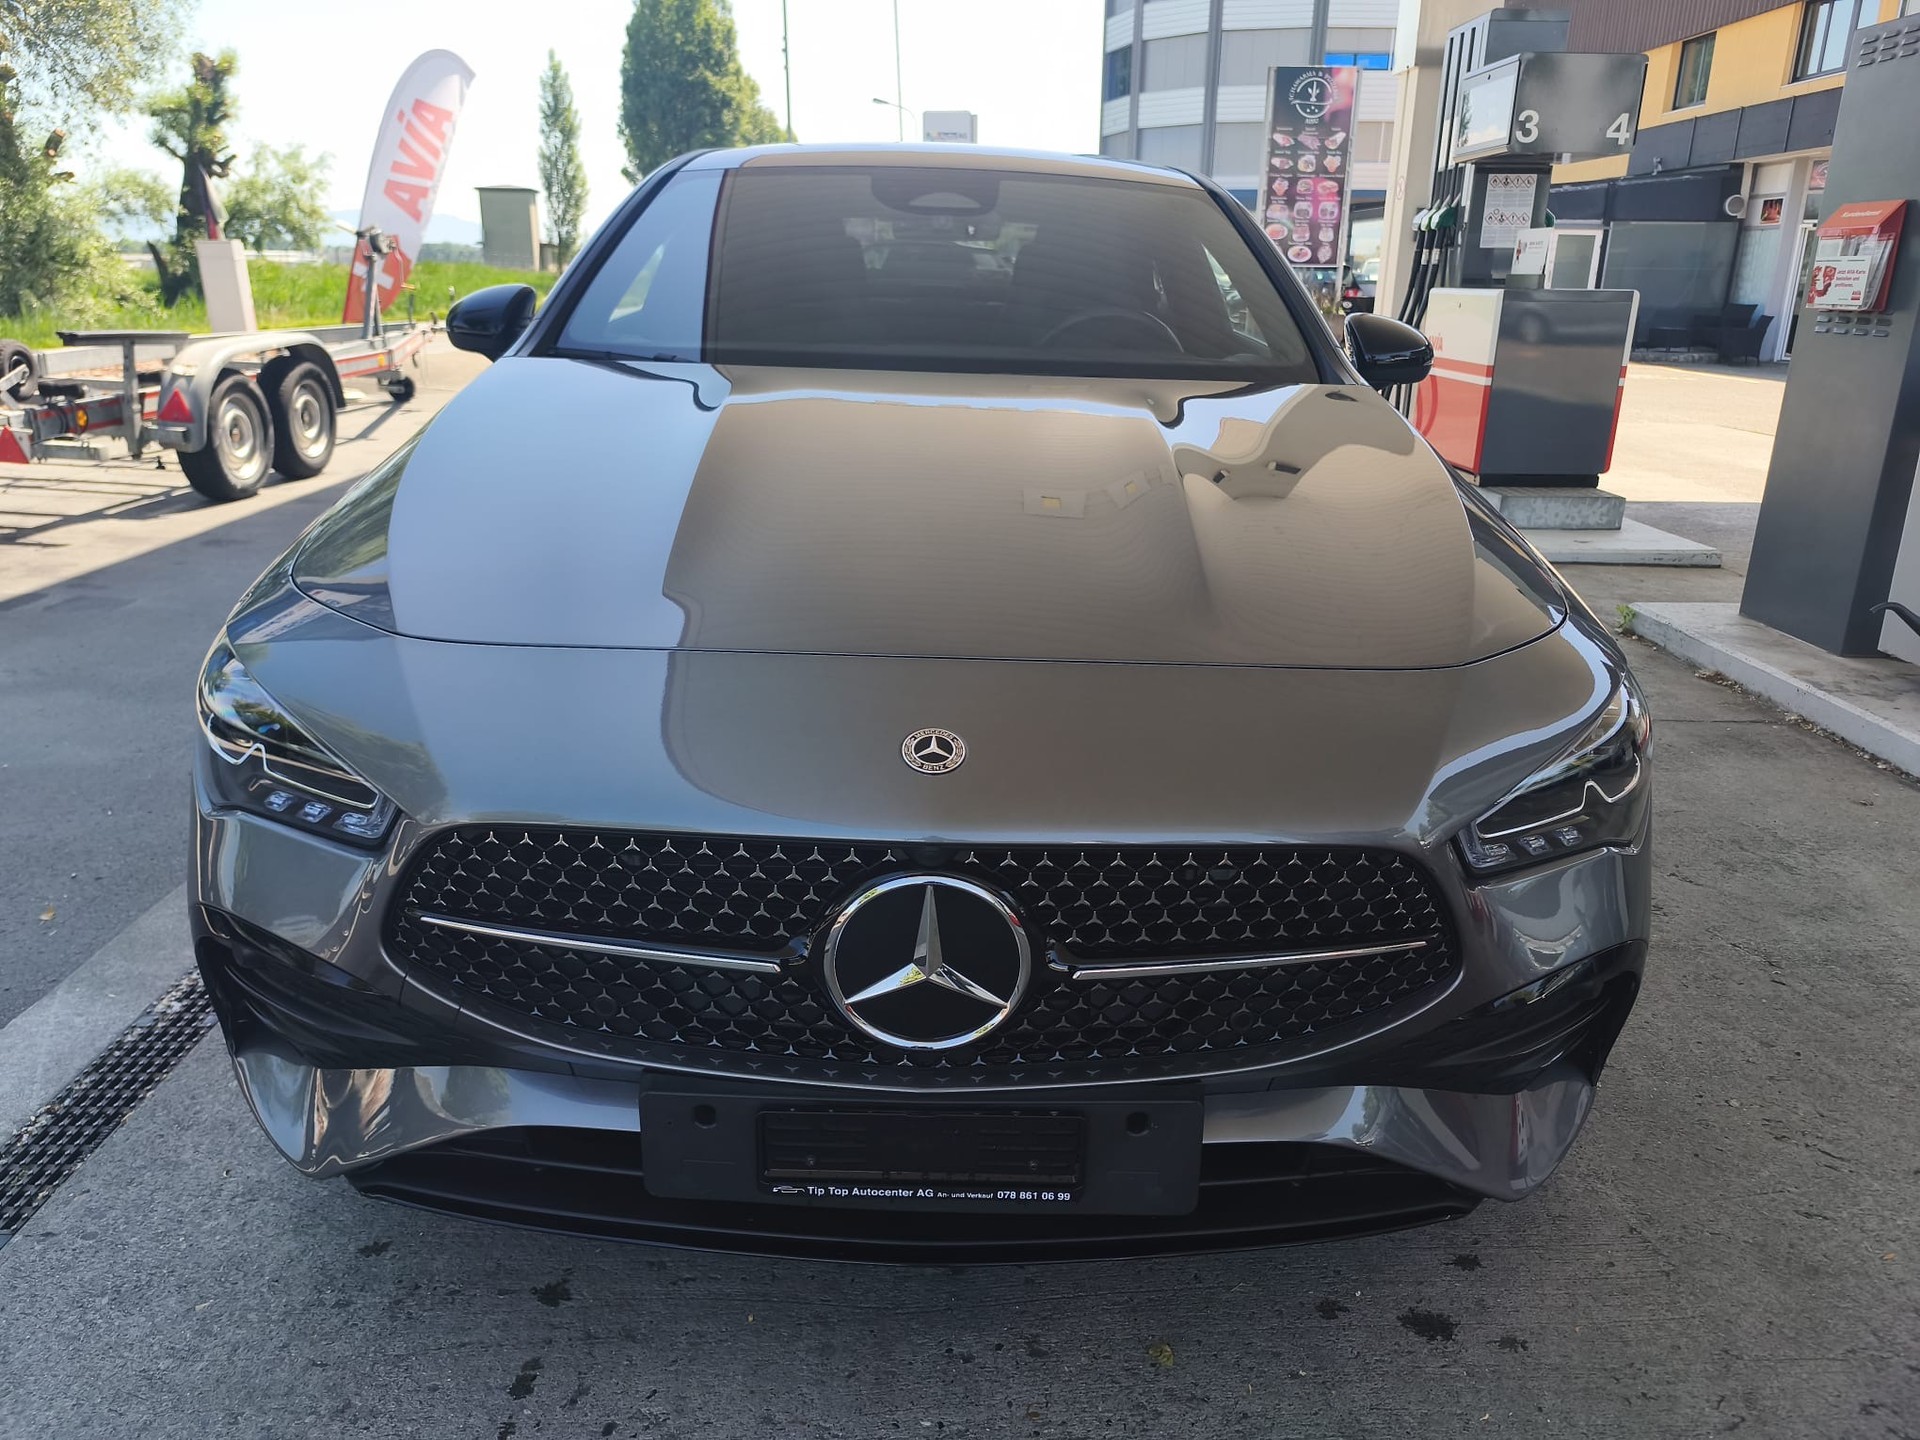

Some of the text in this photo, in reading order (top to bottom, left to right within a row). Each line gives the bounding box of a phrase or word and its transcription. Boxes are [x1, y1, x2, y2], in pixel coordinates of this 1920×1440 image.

[1515, 109, 1540, 144] 3
[1605, 112, 1631, 145] 4
[383, 98, 453, 223] AVIA
[807, 1186, 825, 1196] Tip
[828, 1186, 849, 1197] Top
[852, 1187, 914, 1197] Autocenter
[916, 1188, 934, 1197] AG
[997, 1190, 1016, 1199] 078
[1019, 1191, 1038, 1200] 861
[1041, 1191, 1055, 1200] 06
[1057, 1192, 1071, 1201] 99
